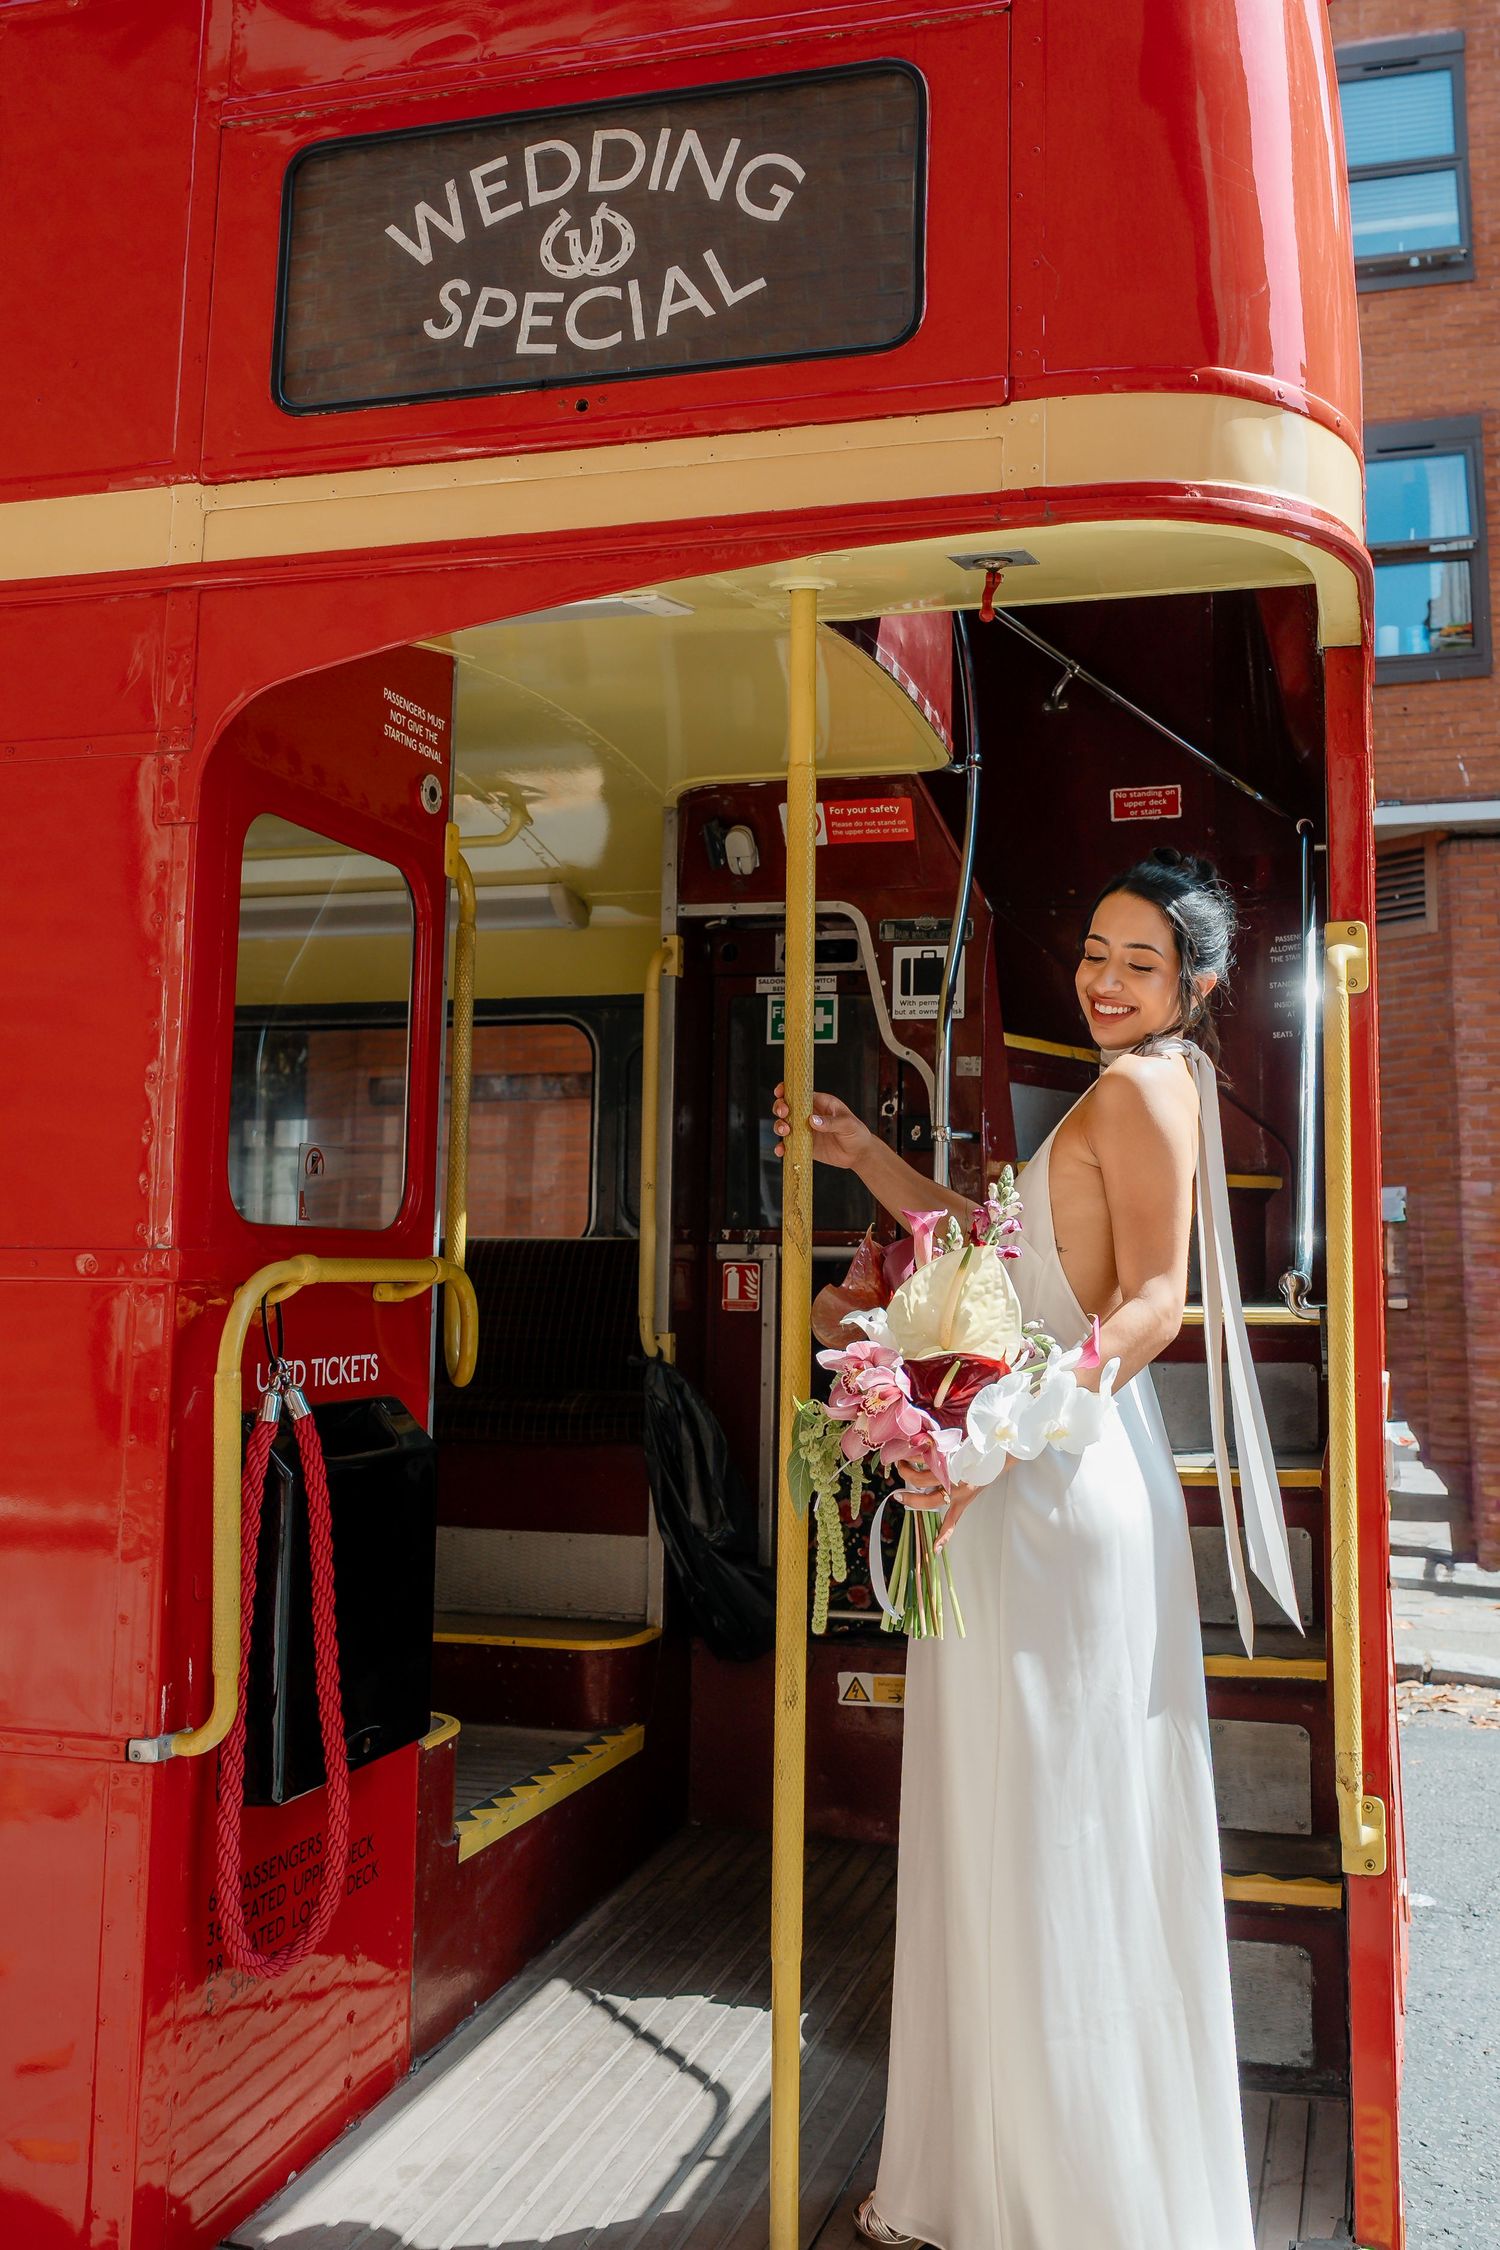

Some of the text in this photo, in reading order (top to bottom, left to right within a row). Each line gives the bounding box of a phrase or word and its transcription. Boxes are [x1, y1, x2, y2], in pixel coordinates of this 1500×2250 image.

[385, 127, 806, 266] WEDDING
[423, 249, 767, 355] SPECIAL
[383, 687, 445, 731] PASSENGERS MUST
[390, 709, 438, 744] NOT GIVE THE
[383, 724, 442, 764] STARTING SIGNAL
[829, 804, 900, 816] For your safety
[1115, 791, 1127, 799] No
[1129, 790, 1162, 798] standing
[1123, 798, 1167, 808] upper deck
[1140, 808, 1162, 816] stairs
[1275, 933, 1302, 943] PASSEN
[1272, 1030, 1294, 1039] SEATS
[311, 1353, 379, 1387] TICKETS
[240, 1832, 323, 1891] ASSENGERS
[242, 1884, 287, 1926] EATED
[293, 1861, 325, 1897] UPPE
[350, 1833, 374, 1864] ECK
[251, 1915, 286, 1950] ATED
[346, 1859, 379, 1896] DECK
